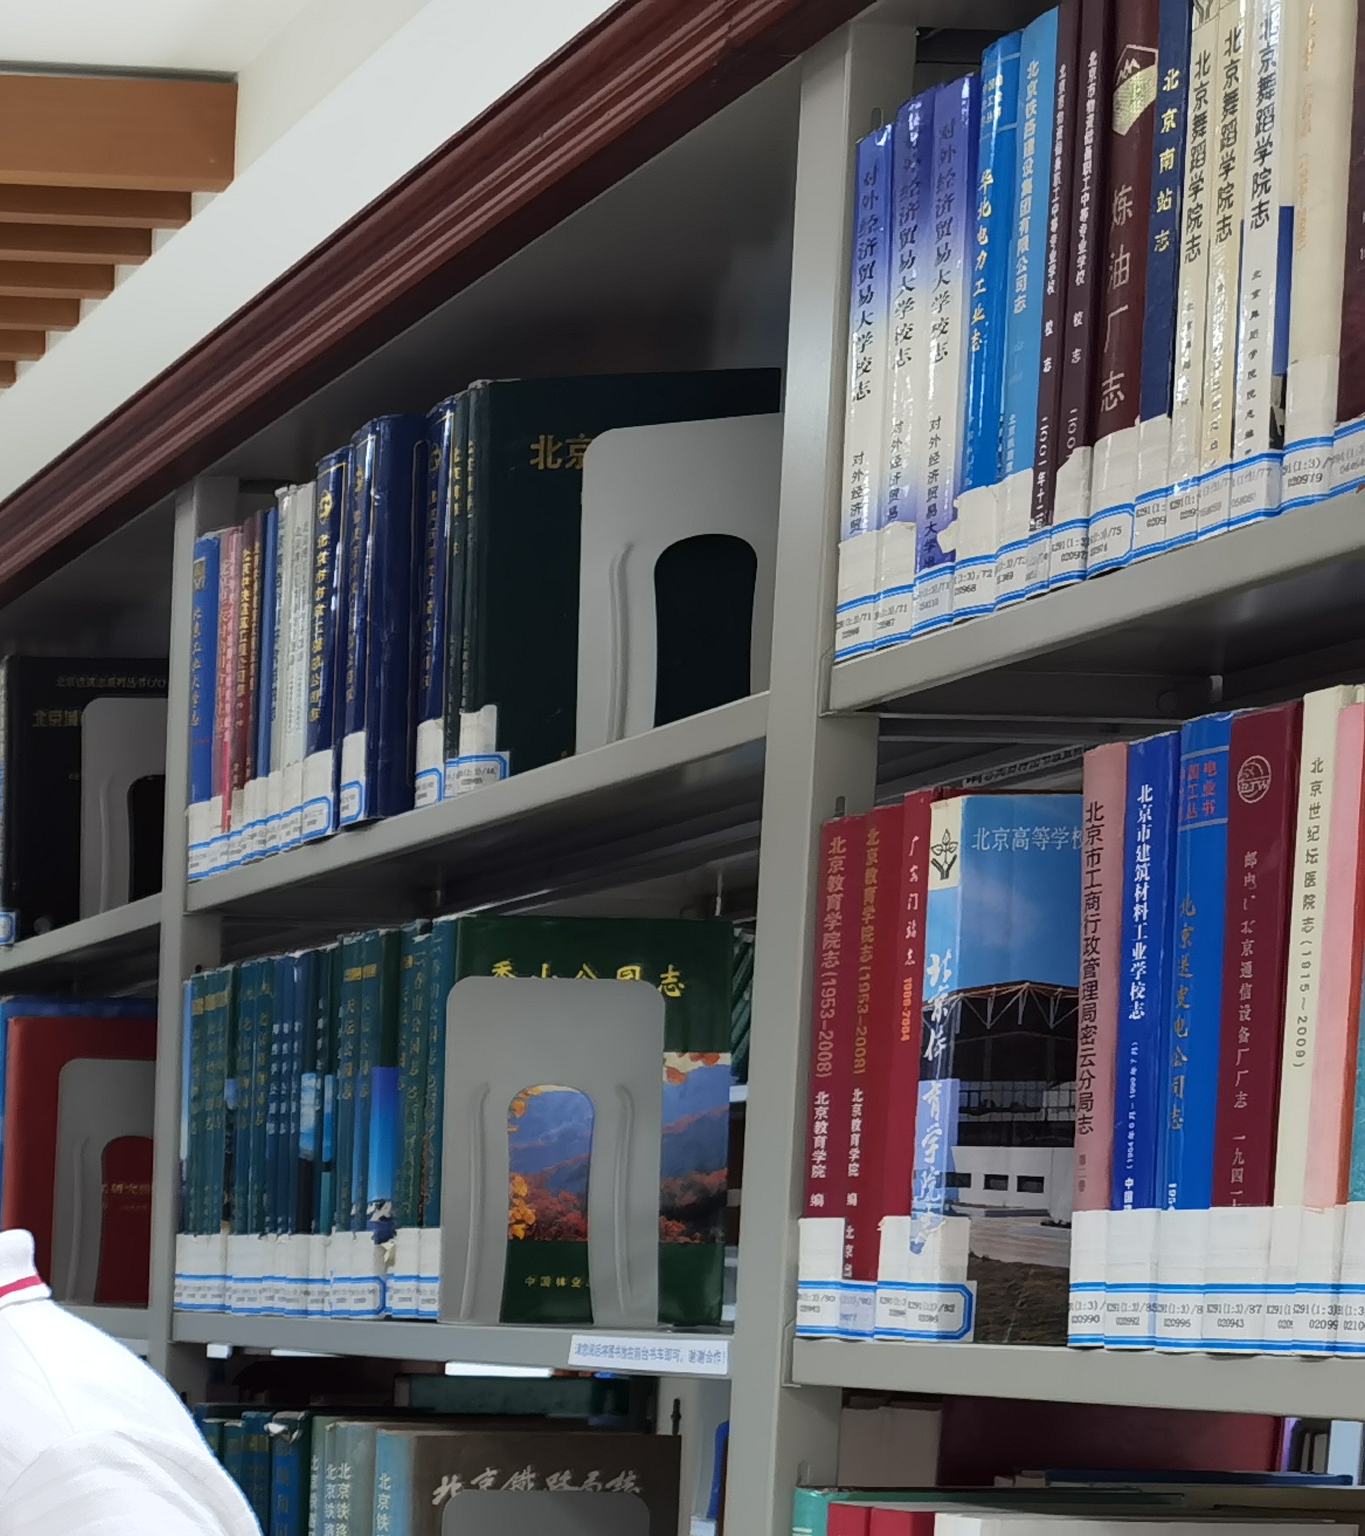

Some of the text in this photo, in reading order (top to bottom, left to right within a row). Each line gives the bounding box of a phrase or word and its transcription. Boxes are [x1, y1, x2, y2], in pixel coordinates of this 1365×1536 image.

[1153, 67, 1181, 253] 北京南站志
[1183, 49, 1212, 264] 北京舞蹈学院志
[1214, 26, 1242, 244] 北京舞蹈学院志
[1249, 18, 1279, 230] 北京舞蹈学院志
[1100, 184, 1134, 413] 炼油厂志
[1076, 801, 1106, 1135] 北京市工商行政管理局密云分局志
[1128, 783, 1154, 1020] 北京市建筑材料工业学校志
